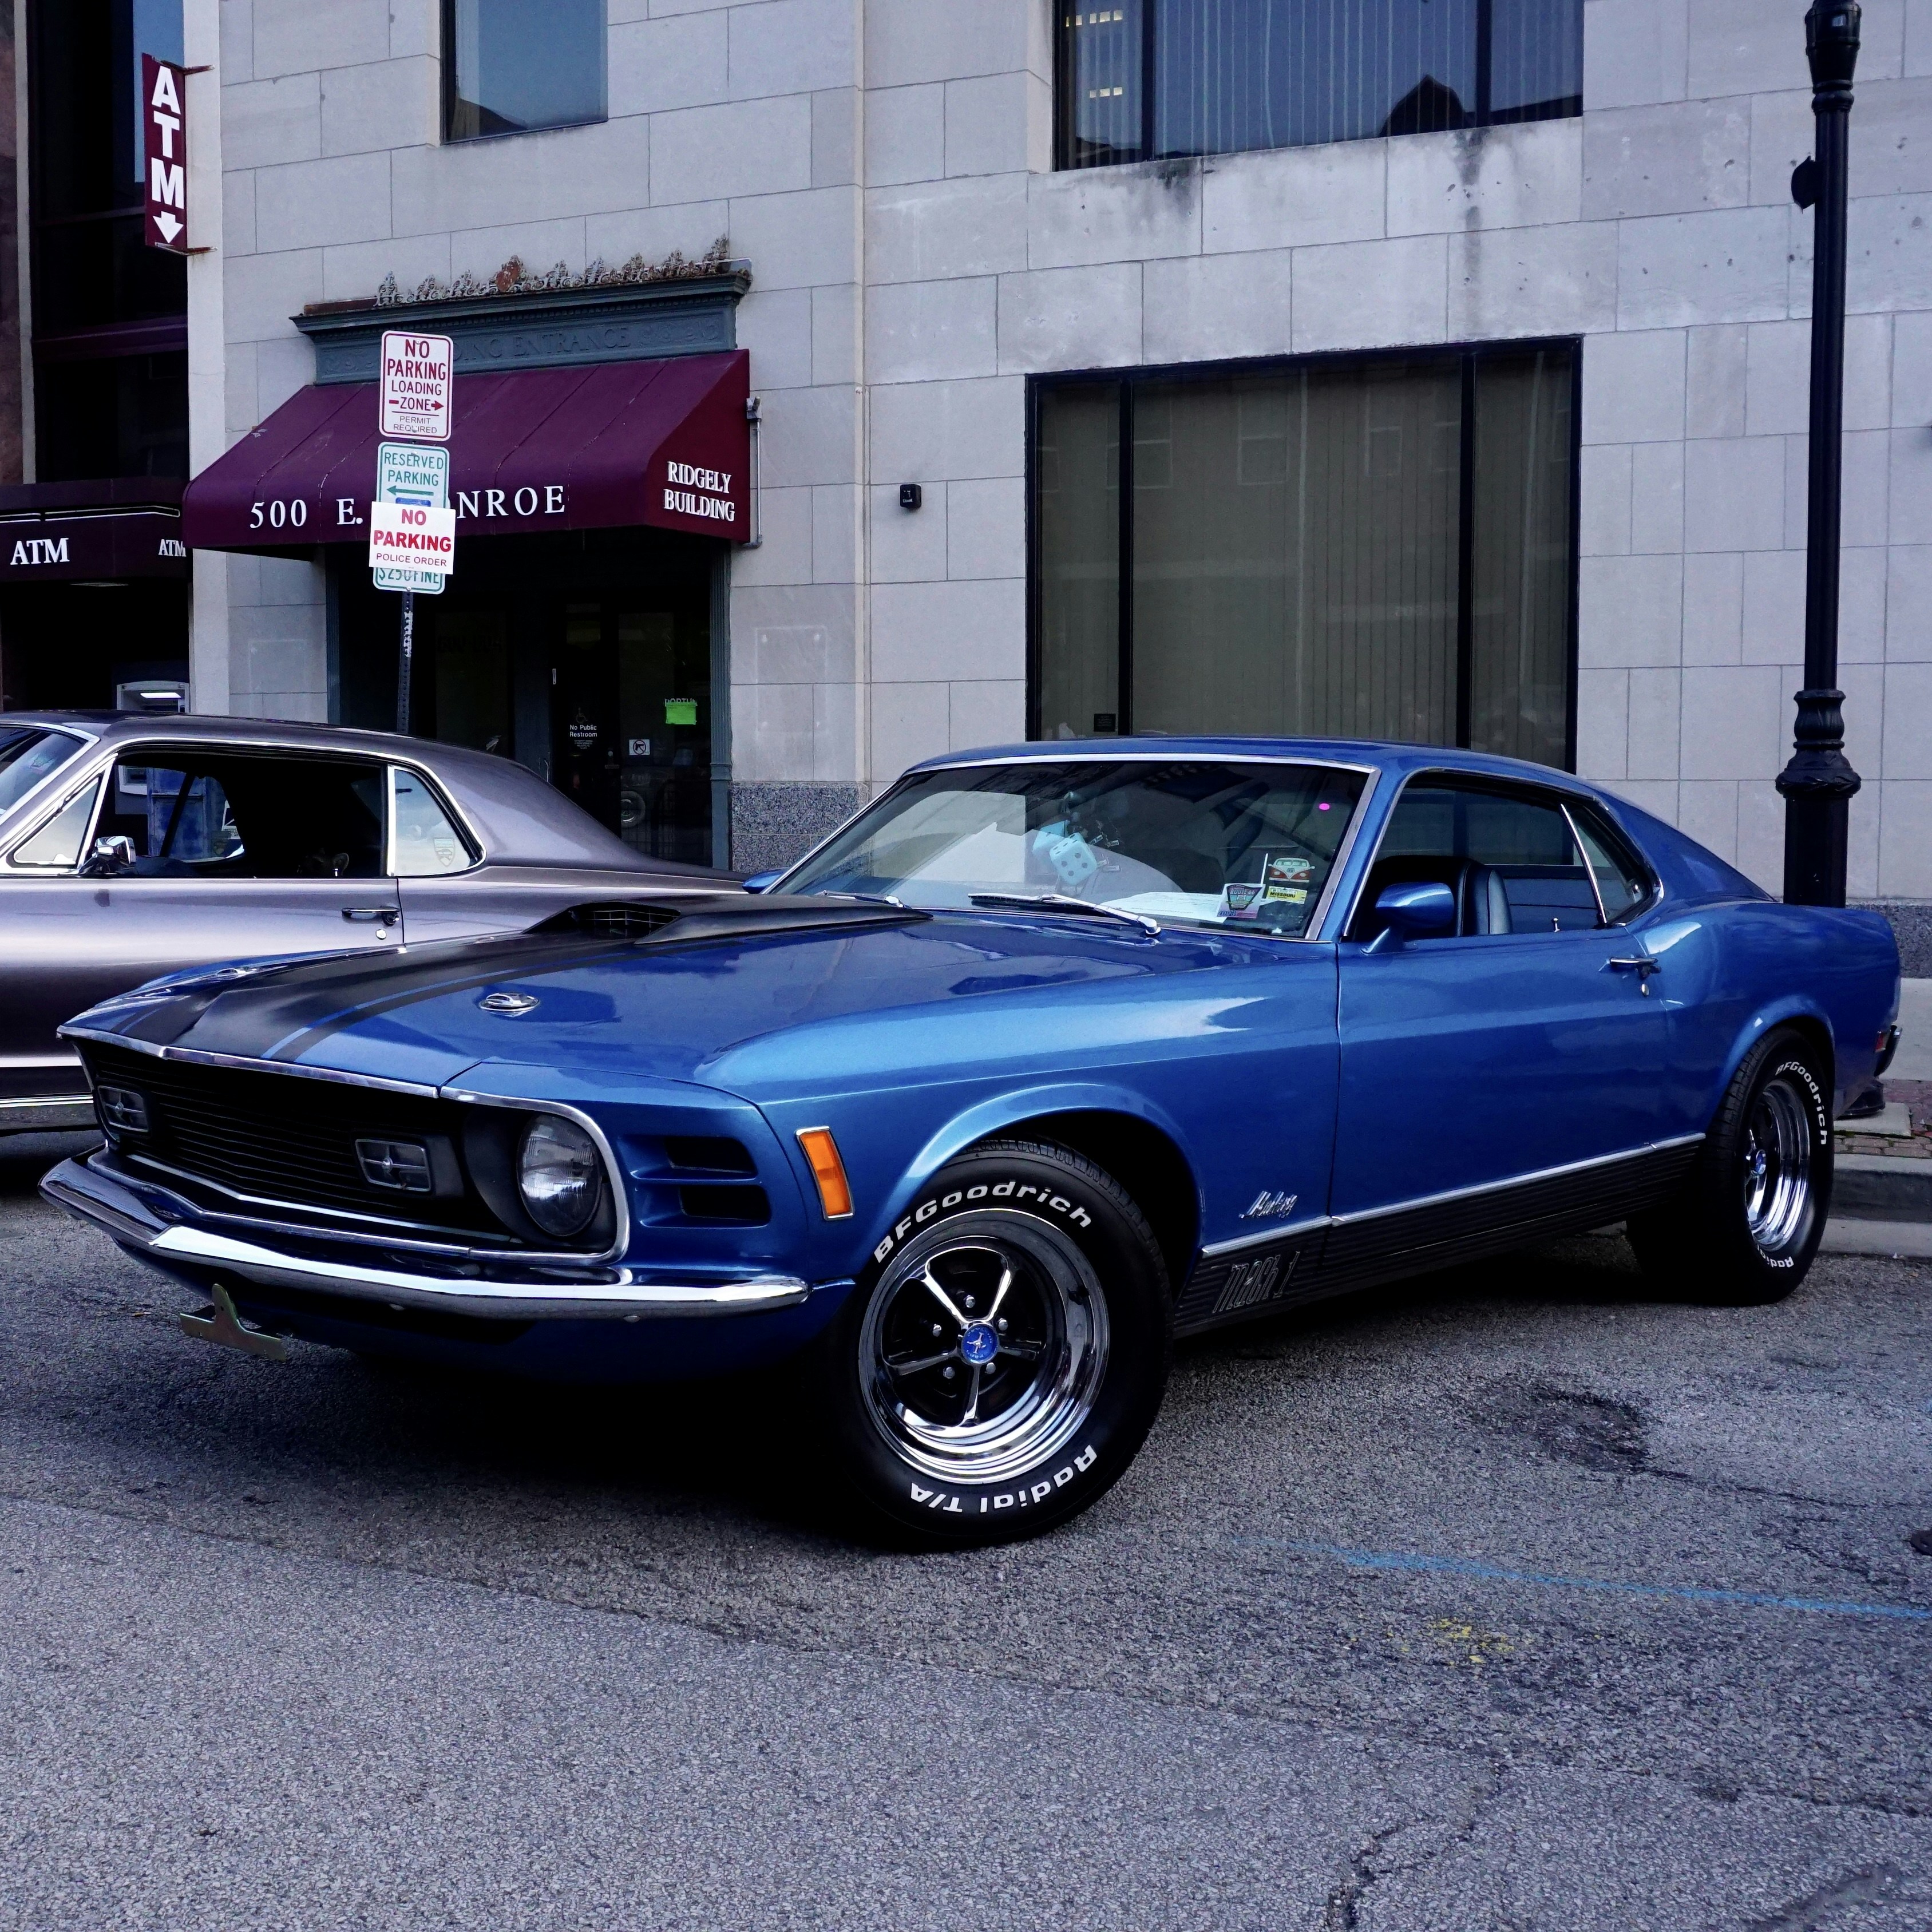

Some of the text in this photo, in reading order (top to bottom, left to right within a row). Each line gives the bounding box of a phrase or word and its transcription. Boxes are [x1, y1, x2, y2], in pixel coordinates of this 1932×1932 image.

[151, 65, 184, 209] ATM
[405, 339, 430, 358] NO
[387, 358, 446, 381] PARKING
[391, 379, 442, 396] LOADING
[400, 397, 431, 411] ZONE
[393, 423, 437, 434] REQUIRED
[399, 415, 431, 425] PERMIT
[384, 452, 444, 470] RESERVED
[387, 469, 439, 486] PARKING
[667, 461, 732, 494] RIDGELY
[250, 485, 565, 529] 500 E. NROE
[663, 489, 735, 522] BUILDING
[401, 509, 426, 526] NO
[158, 539, 187, 557] ATM
[373, 529, 452, 553] PARKING
[10, 538, 70, 565] ATM
[376, 553, 447, 567] POLICE ORDER
[414, 571, 440, 584] FINE
[873, 1181, 1092, 1263] BFGoodrich
[910, 1444, 1098, 1514] Radial T/A
